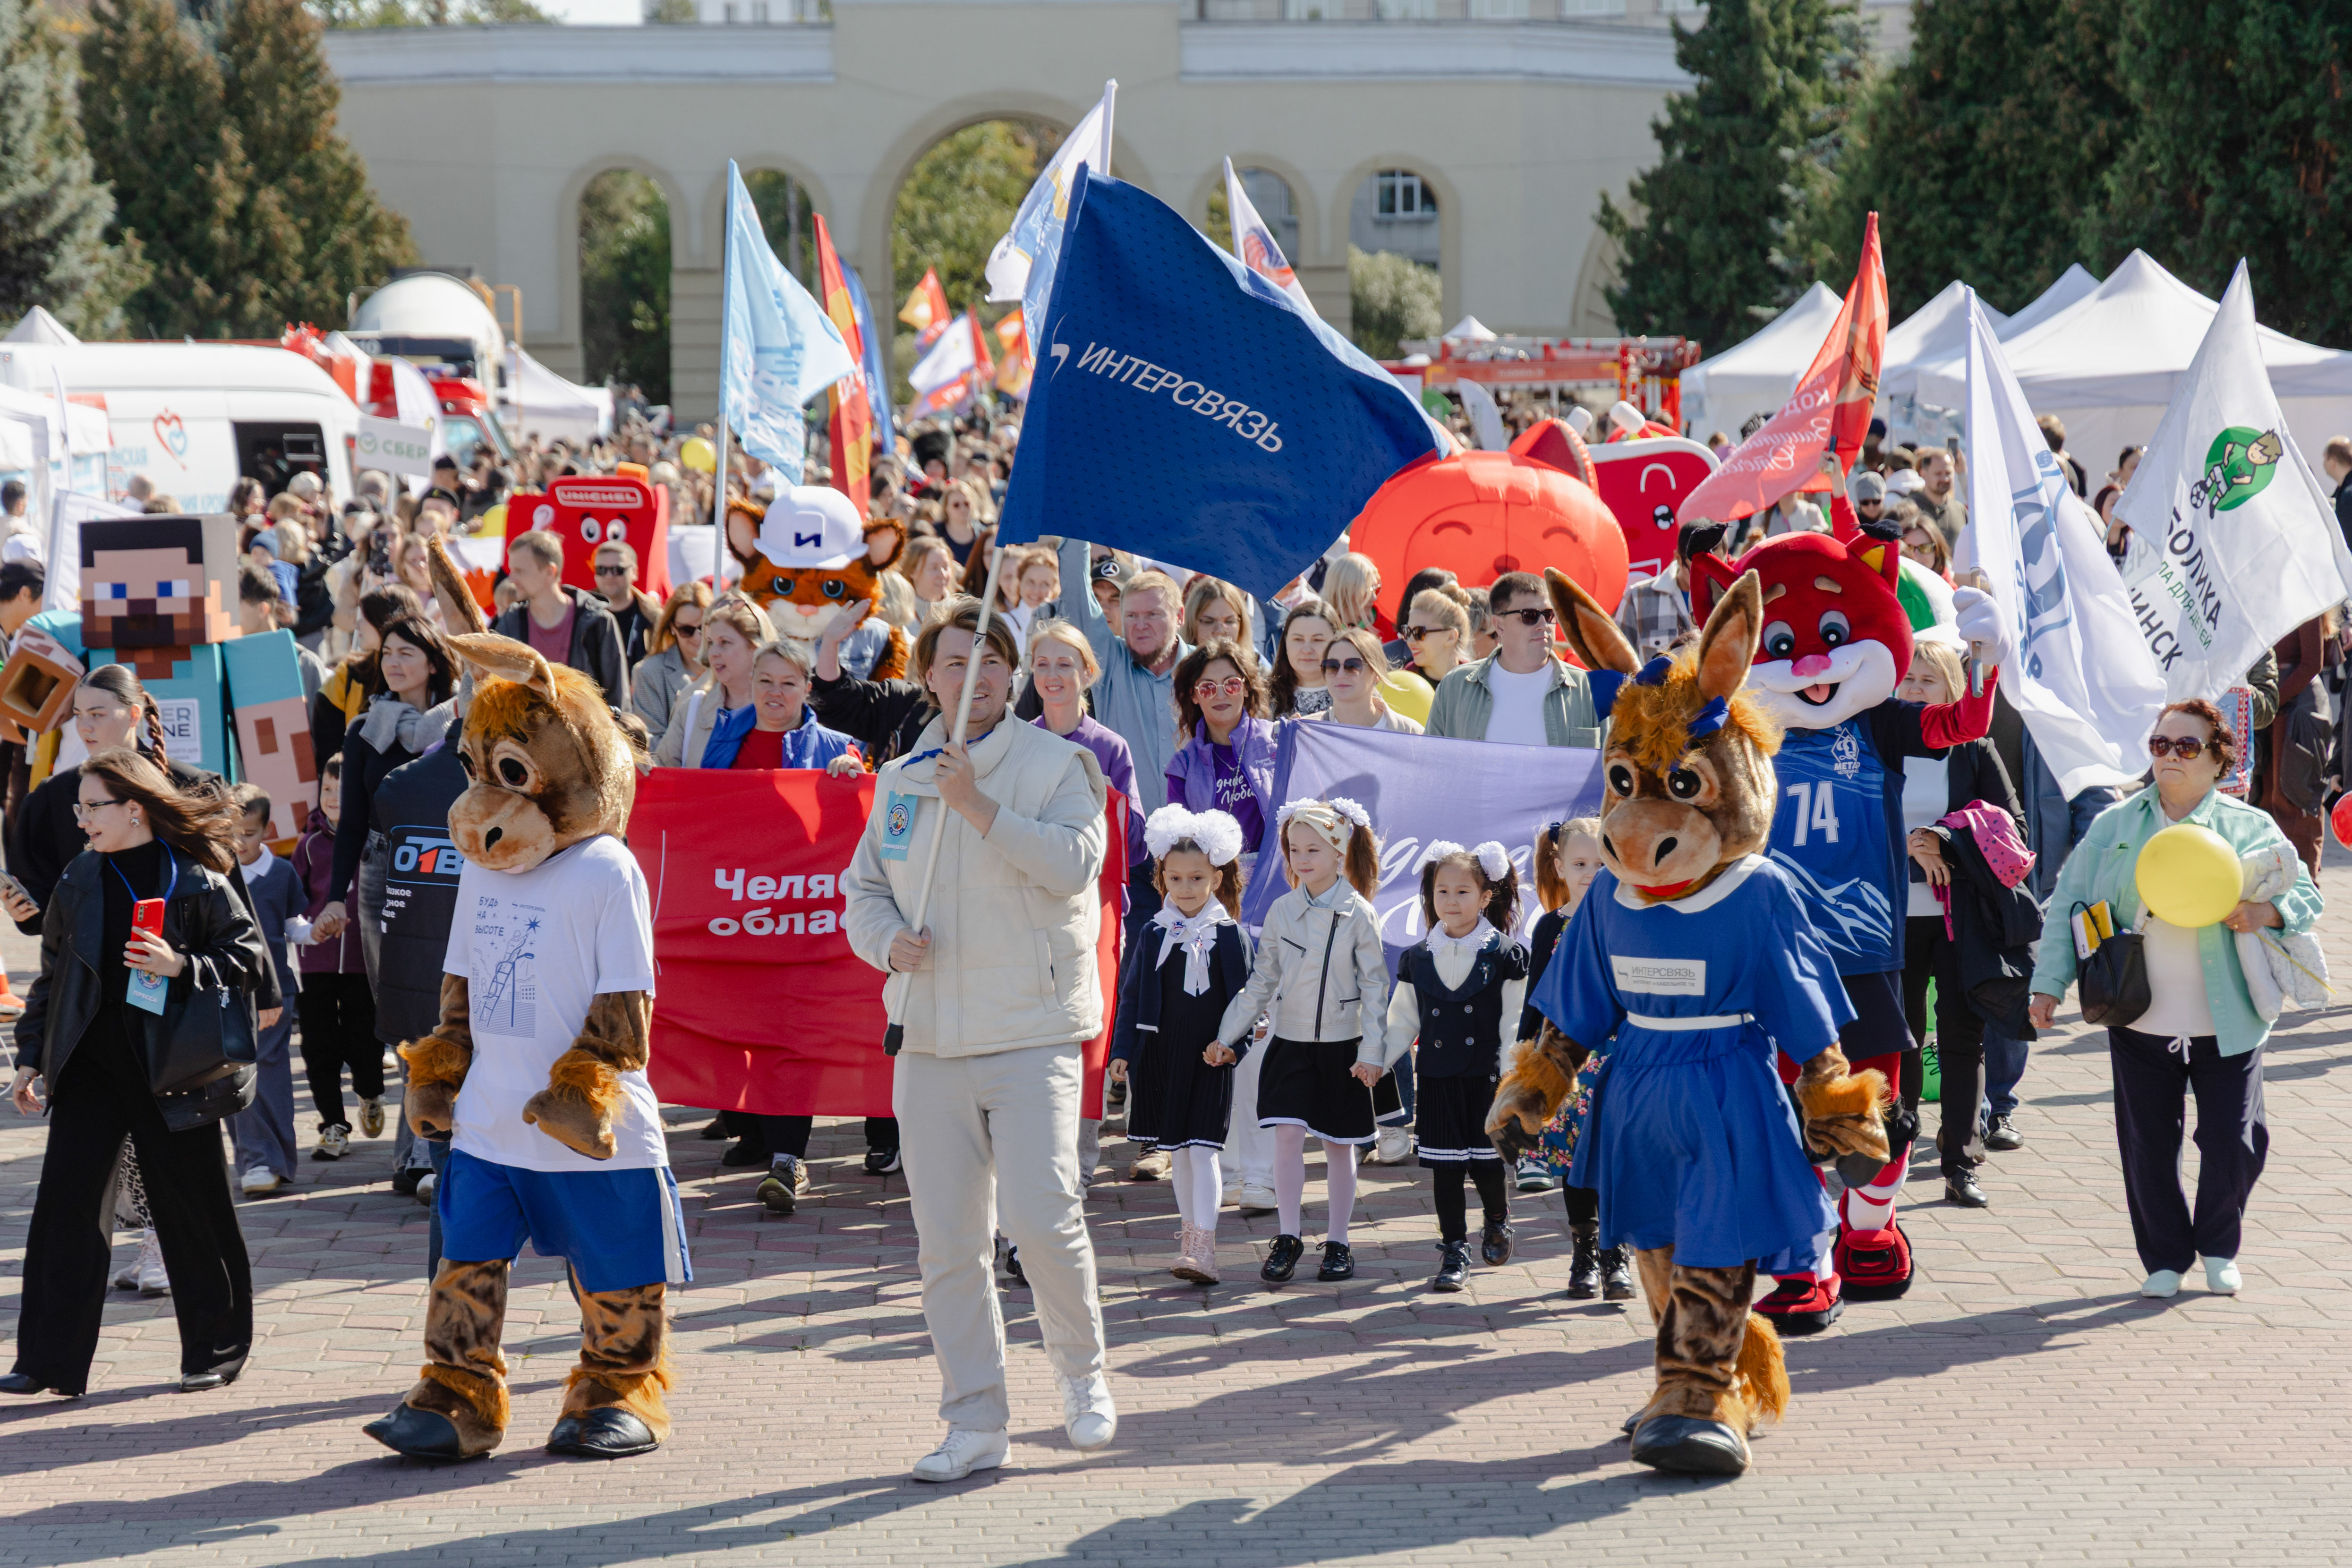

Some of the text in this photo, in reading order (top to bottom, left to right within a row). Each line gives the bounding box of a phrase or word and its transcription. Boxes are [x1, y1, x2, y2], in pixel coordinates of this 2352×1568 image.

[1076, 342, 1283, 452] ИНТЕРСВЯЗЬ
[383, 439, 428, 459] СБЕР
[561, 491, 637, 503] UNICHEL
[2167, 581, 2196, 613] ДЛЯ
[2189, 609, 2213, 651] ДЕТЕЙ
[1834, 761, 1861, 771] МЕТАР
[1216, 775, 1244, 793] дные
[1220, 784, 1254, 804] Люби
[1786, 781, 1840, 847] 74
[479, 896, 498, 908] БУДЬ
[477, 911, 486, 920] НА
[475, 925, 504, 936] ВЫСОТЕ
[1632, 966, 1696, 977] ИНТЕРСВЯЗЬ
[134, 990, 158, 1003] ПРЕССА
